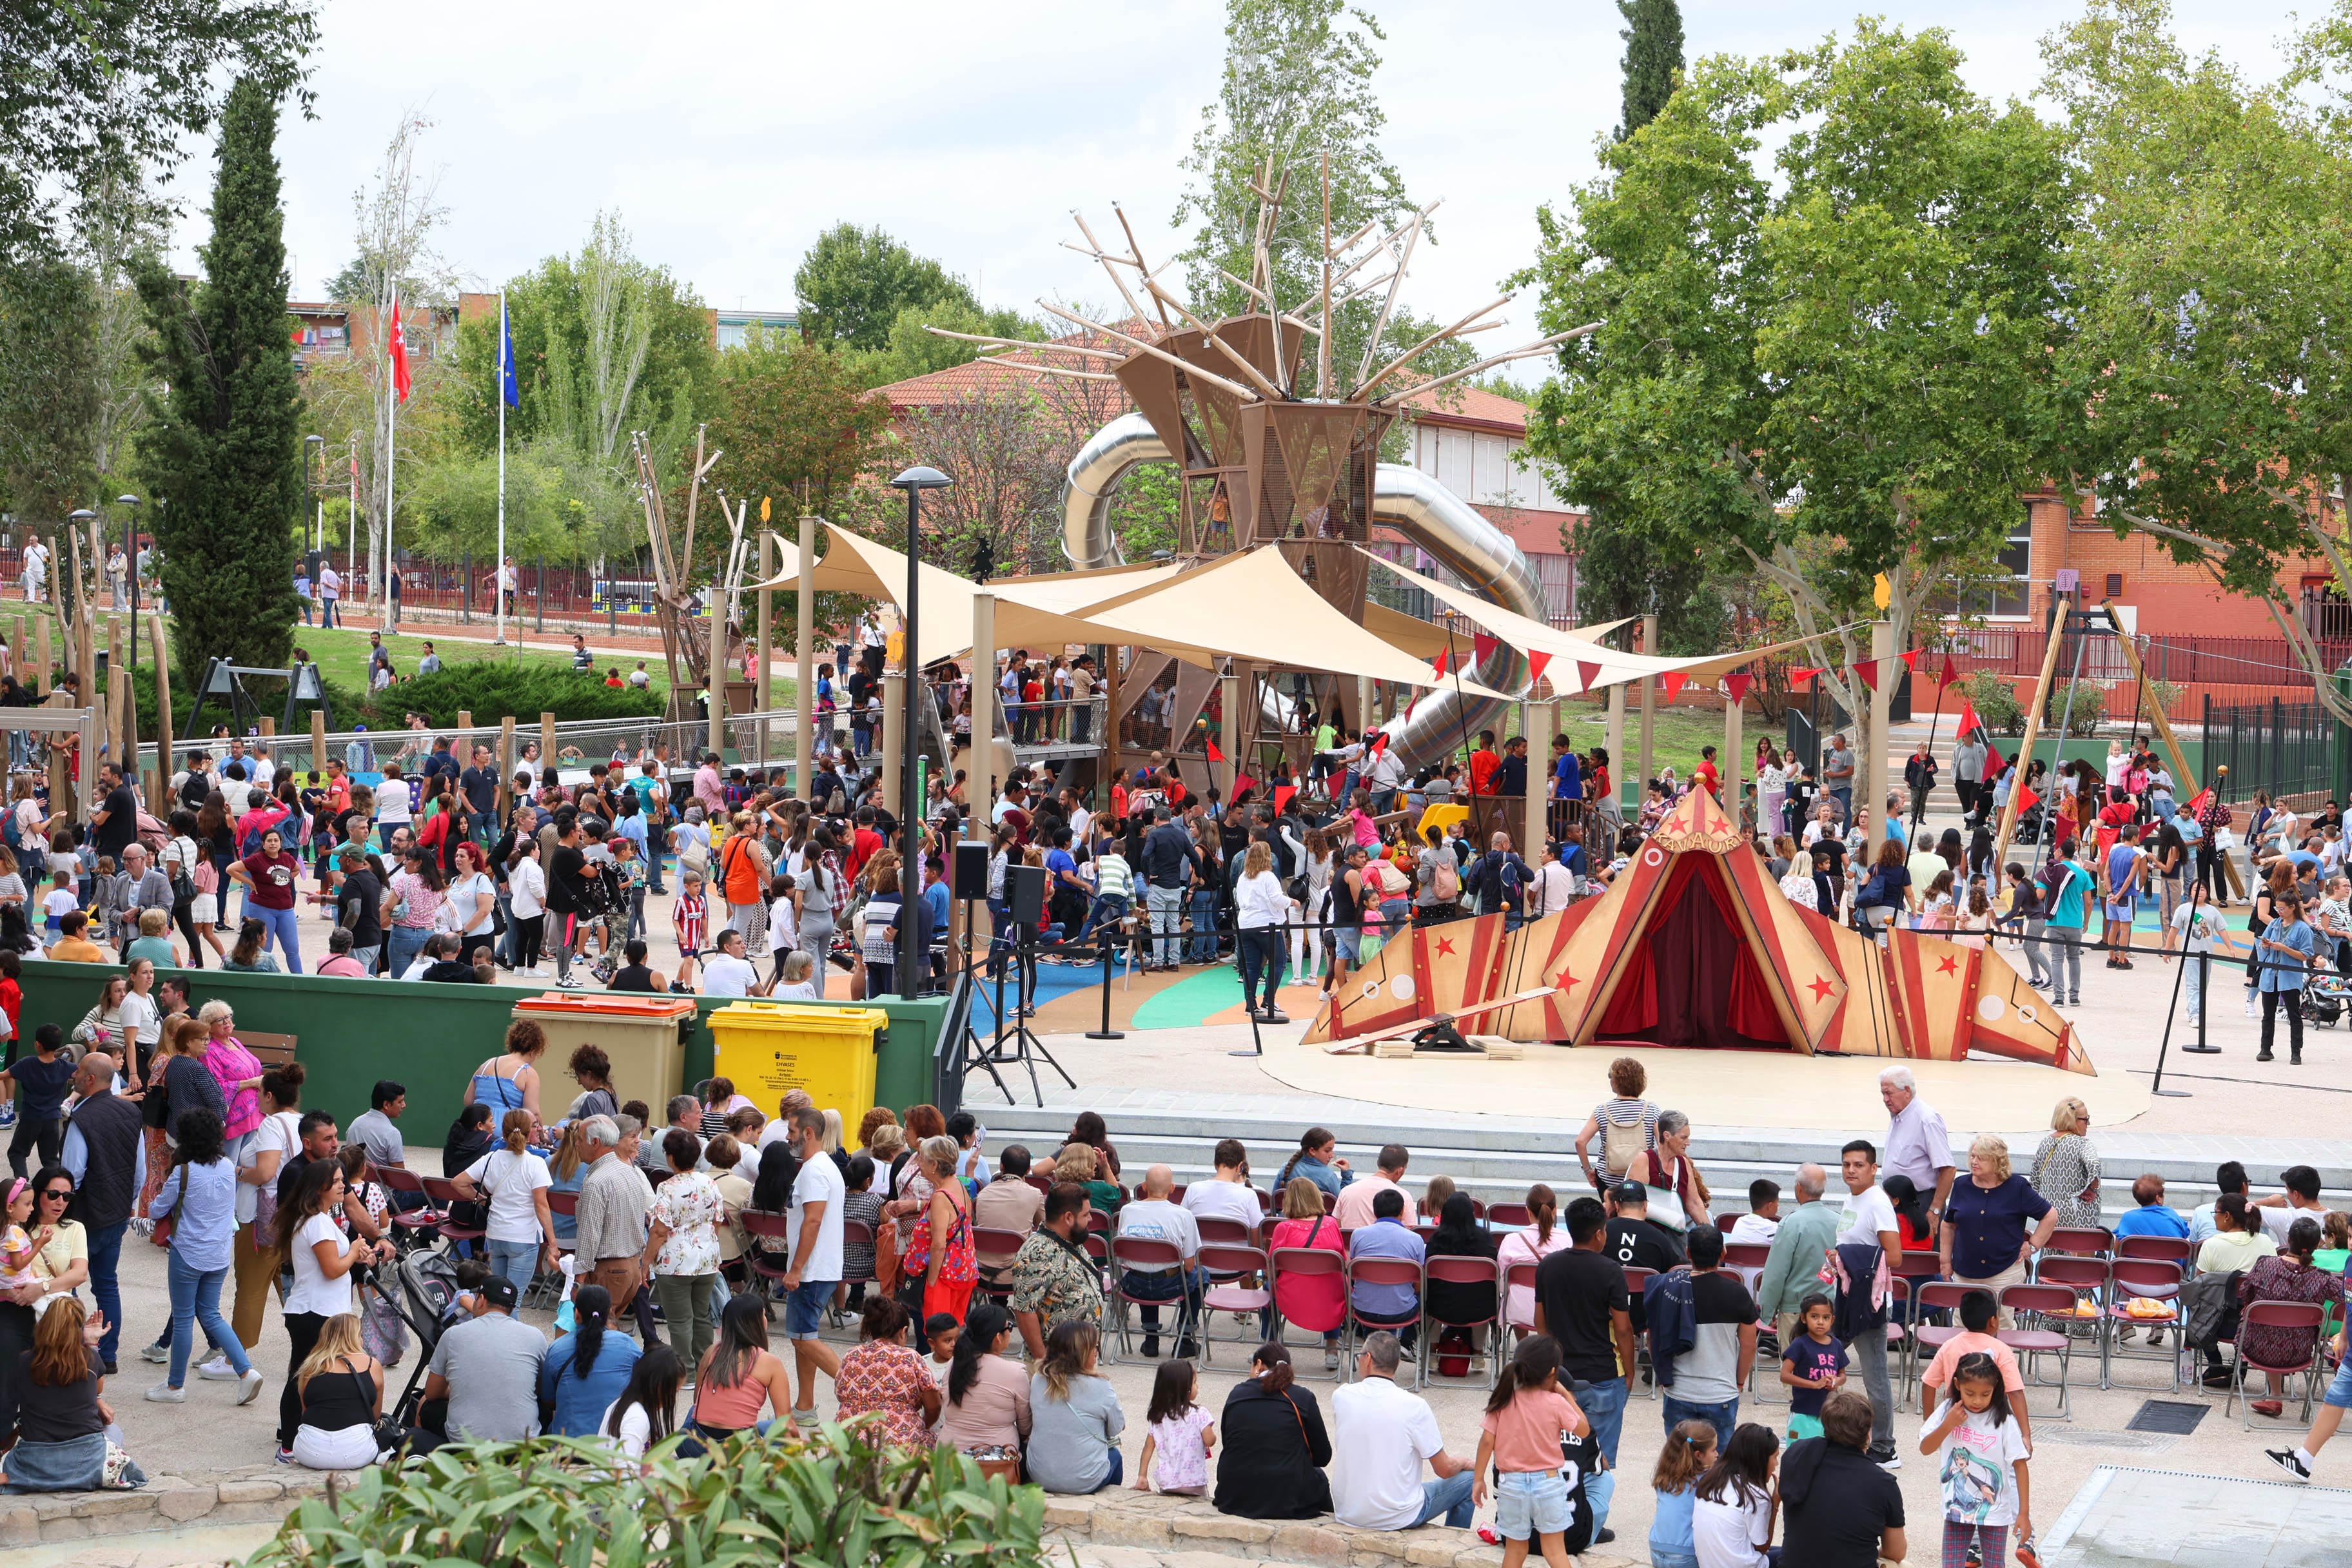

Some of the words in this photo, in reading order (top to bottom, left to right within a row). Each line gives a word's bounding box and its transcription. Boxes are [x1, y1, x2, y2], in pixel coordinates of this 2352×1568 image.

[1653, 832, 1743, 853] KAVAURI
[43, 1241, 72, 1251] OSS
[1818, 1353, 1835, 1366] BE
